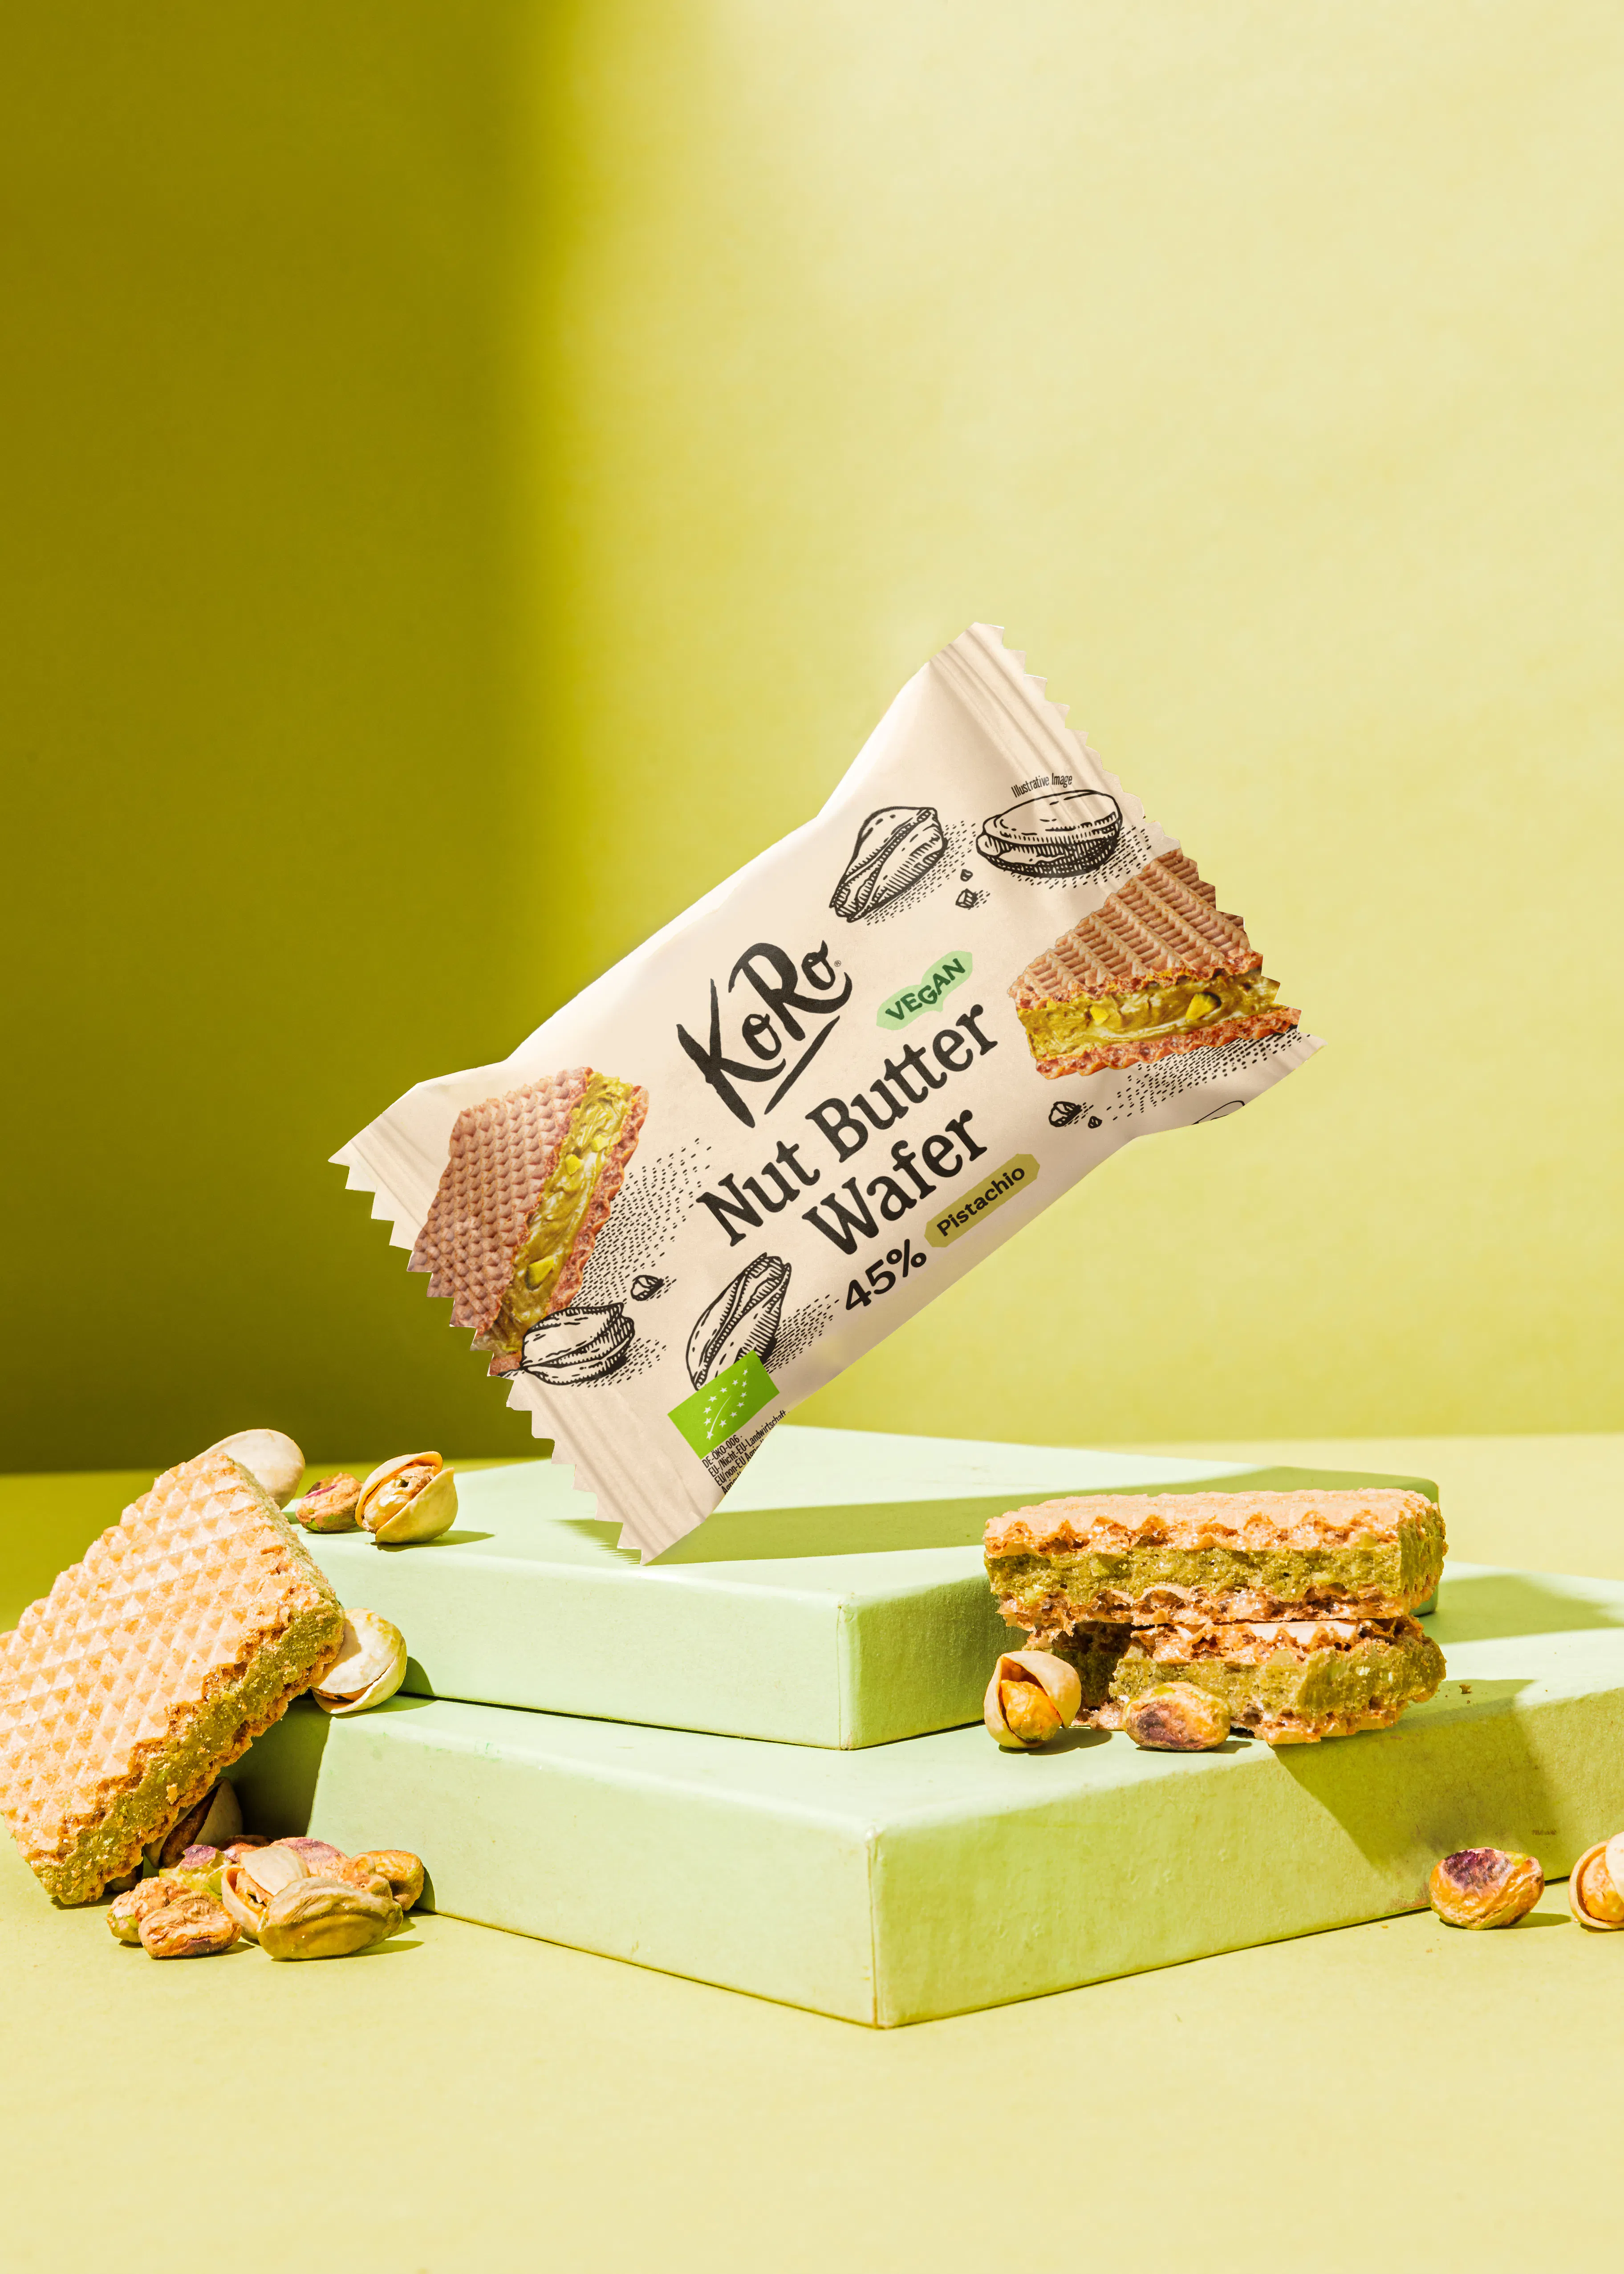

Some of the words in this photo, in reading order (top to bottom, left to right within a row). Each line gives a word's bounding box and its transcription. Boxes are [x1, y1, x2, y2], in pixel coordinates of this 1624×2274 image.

[1011, 776, 1049, 798] Illustrative
[1052, 773, 1072, 788] Image
[676, 940, 853, 1128] KoRo
[885, 958, 966, 1021] VEGAN
[696, 1141, 820, 1247] Nut
[805, 1004, 998, 1163] Butter
[802, 1110, 987, 1255] Wafer
[846, 1239, 927, 1310] 45%
[937, 1168, 1025, 1237] Pistachio
[702, 1435, 740, 1468] DE-ÖKO-006
[714, 1456, 747, 1486] EU/non-EU
